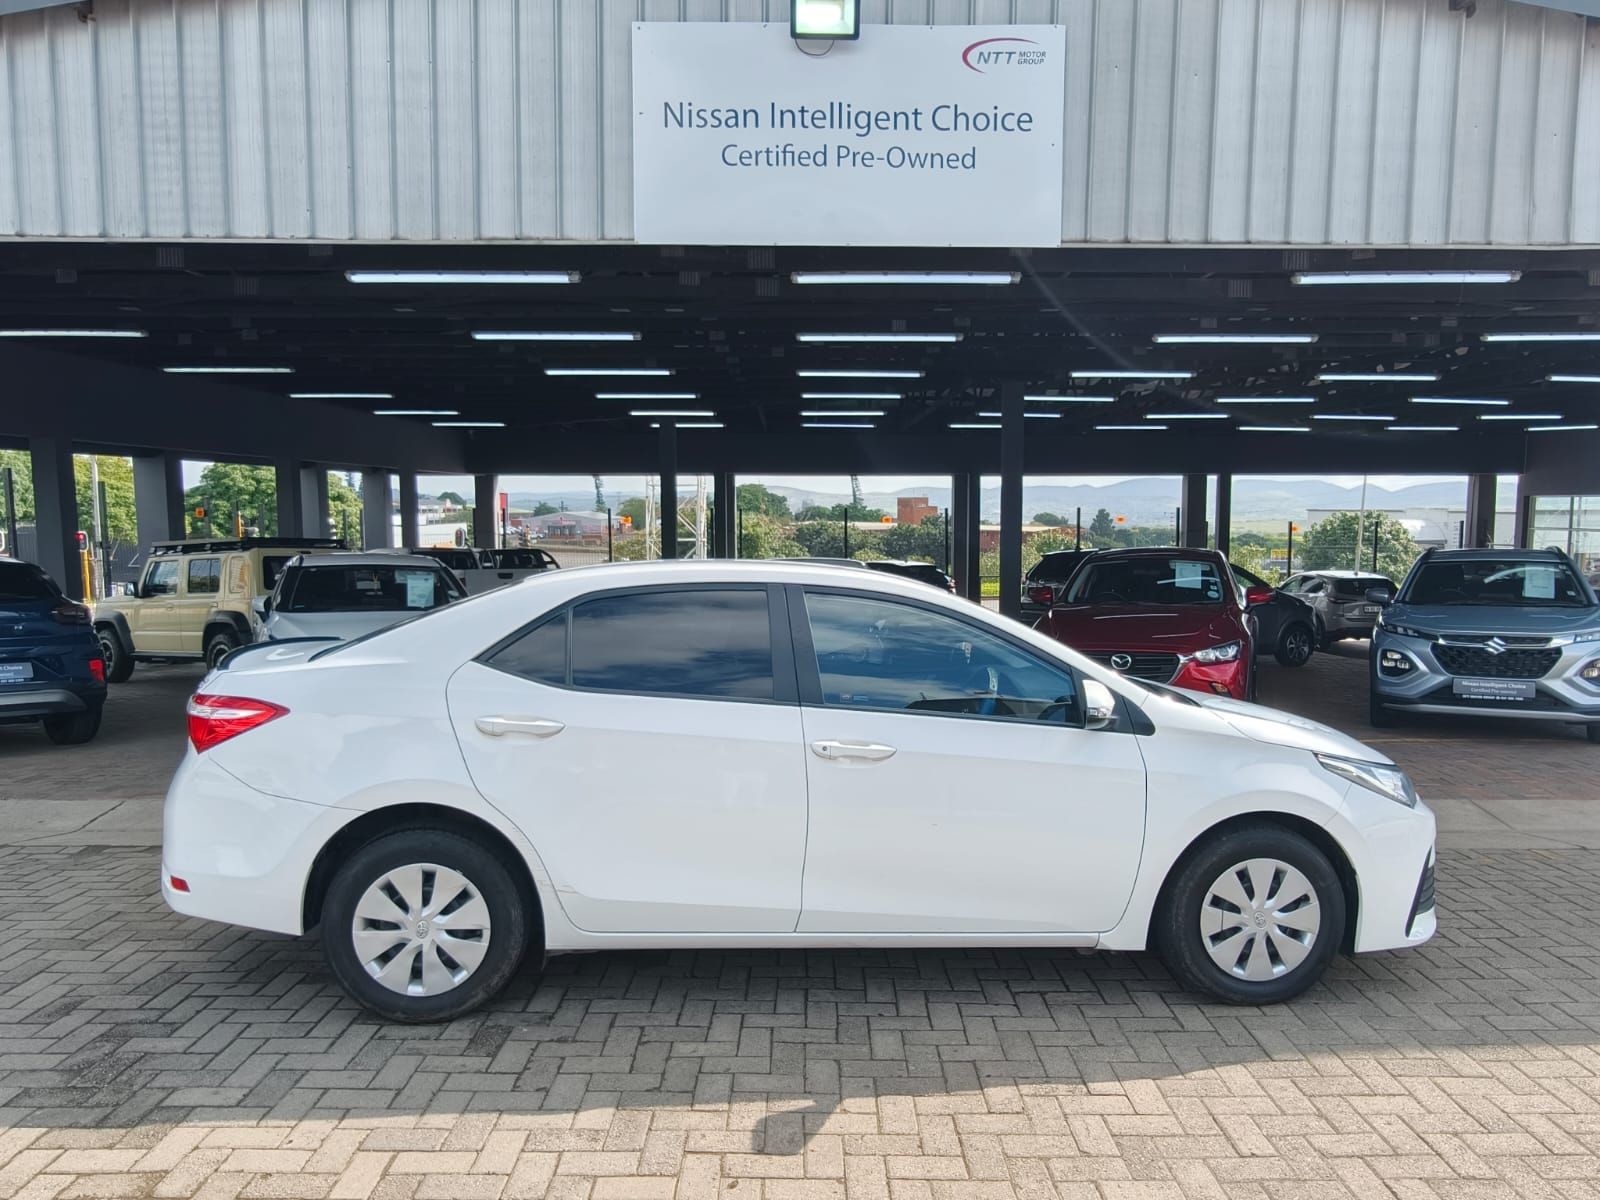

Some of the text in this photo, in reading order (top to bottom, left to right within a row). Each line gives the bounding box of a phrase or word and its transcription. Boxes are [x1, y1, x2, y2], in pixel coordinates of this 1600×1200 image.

[977, 51, 1017, 65] NTT
[1018, 50, 1047, 58] MOTOR
[663, 101, 1034, 138] Nissan Intelligent Choice
[721, 143, 977, 170] Certified Pre-Owned
